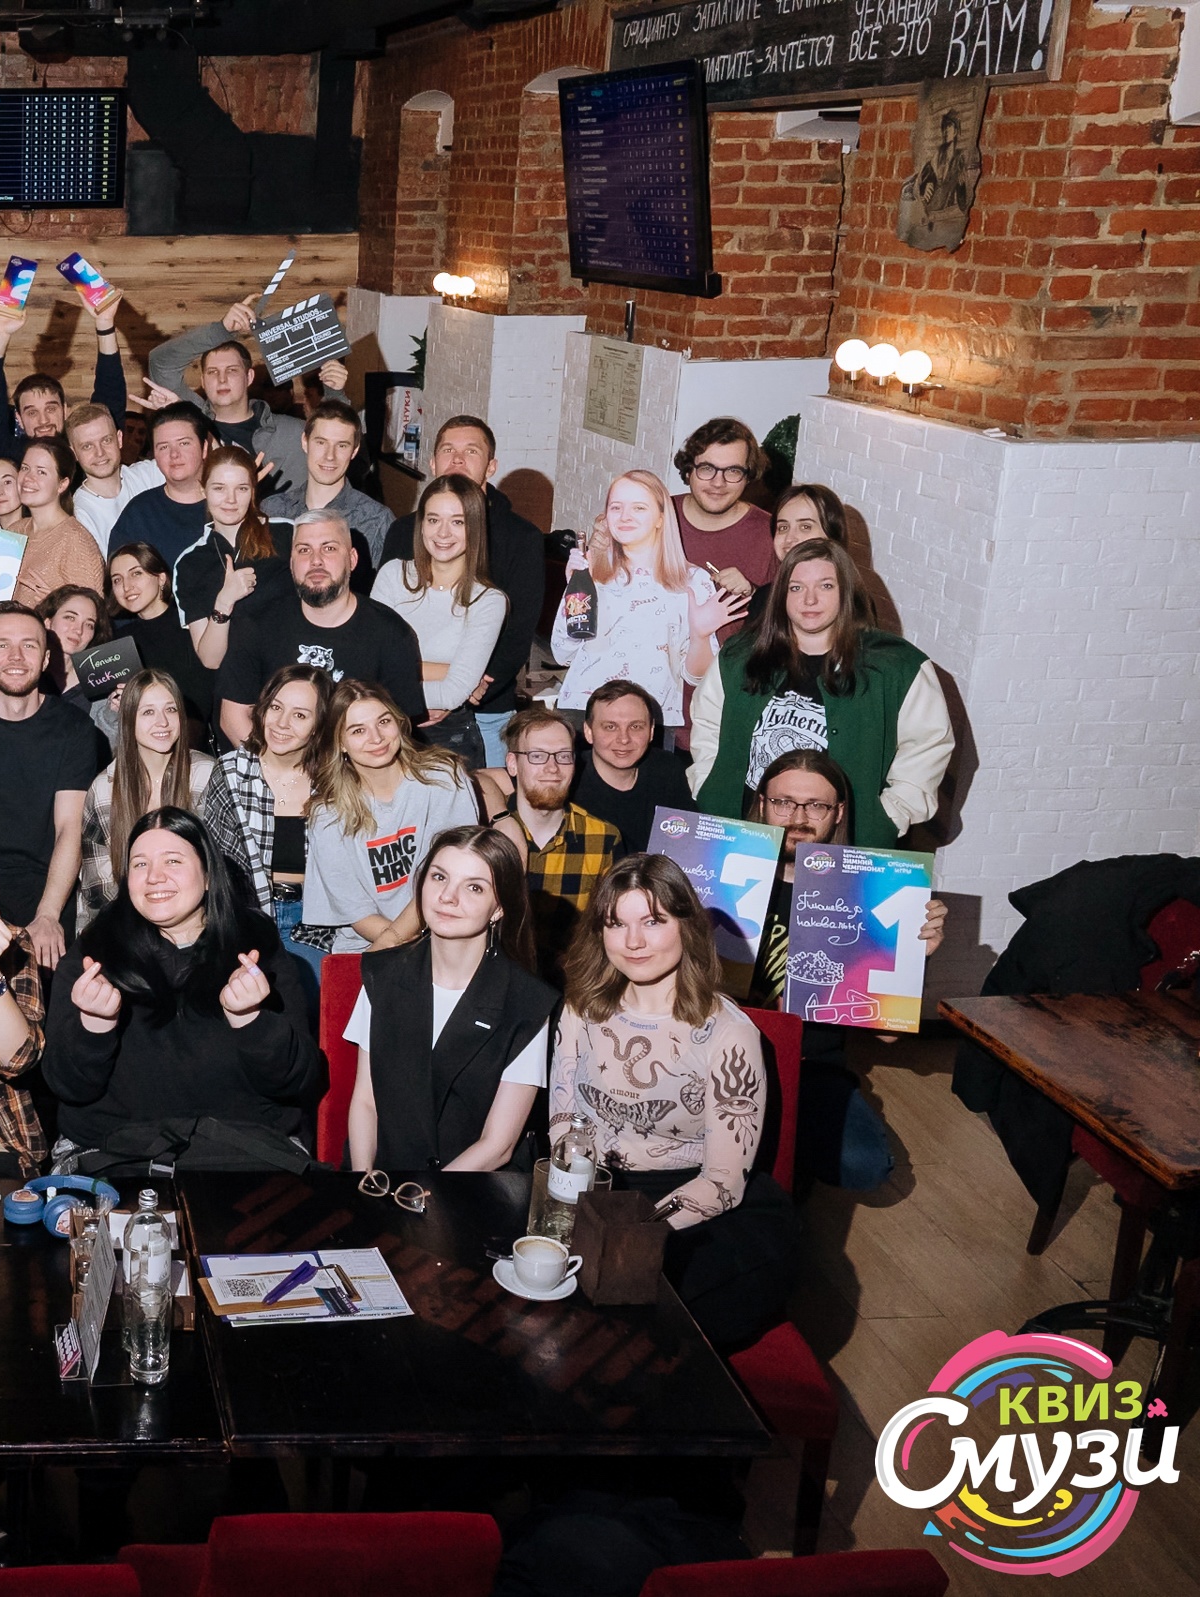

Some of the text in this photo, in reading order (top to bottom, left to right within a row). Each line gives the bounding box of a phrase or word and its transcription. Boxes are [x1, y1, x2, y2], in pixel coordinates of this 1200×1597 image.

[623, 12, 681, 49] ОФИЦИАНТУ
[693, 0, 761, 32] ЗАПЛАТИТЕ
[891, 18, 932, 57] ЭТО
[10, 270, 35, 301] 2
[73, 258, 104, 289] 3
[259, 320, 293, 340] UNIVERSAL
[368, 834, 417, 867] MNC
[867, 886, 931, 998] 1
[609, 1088, 640, 1099] amour
